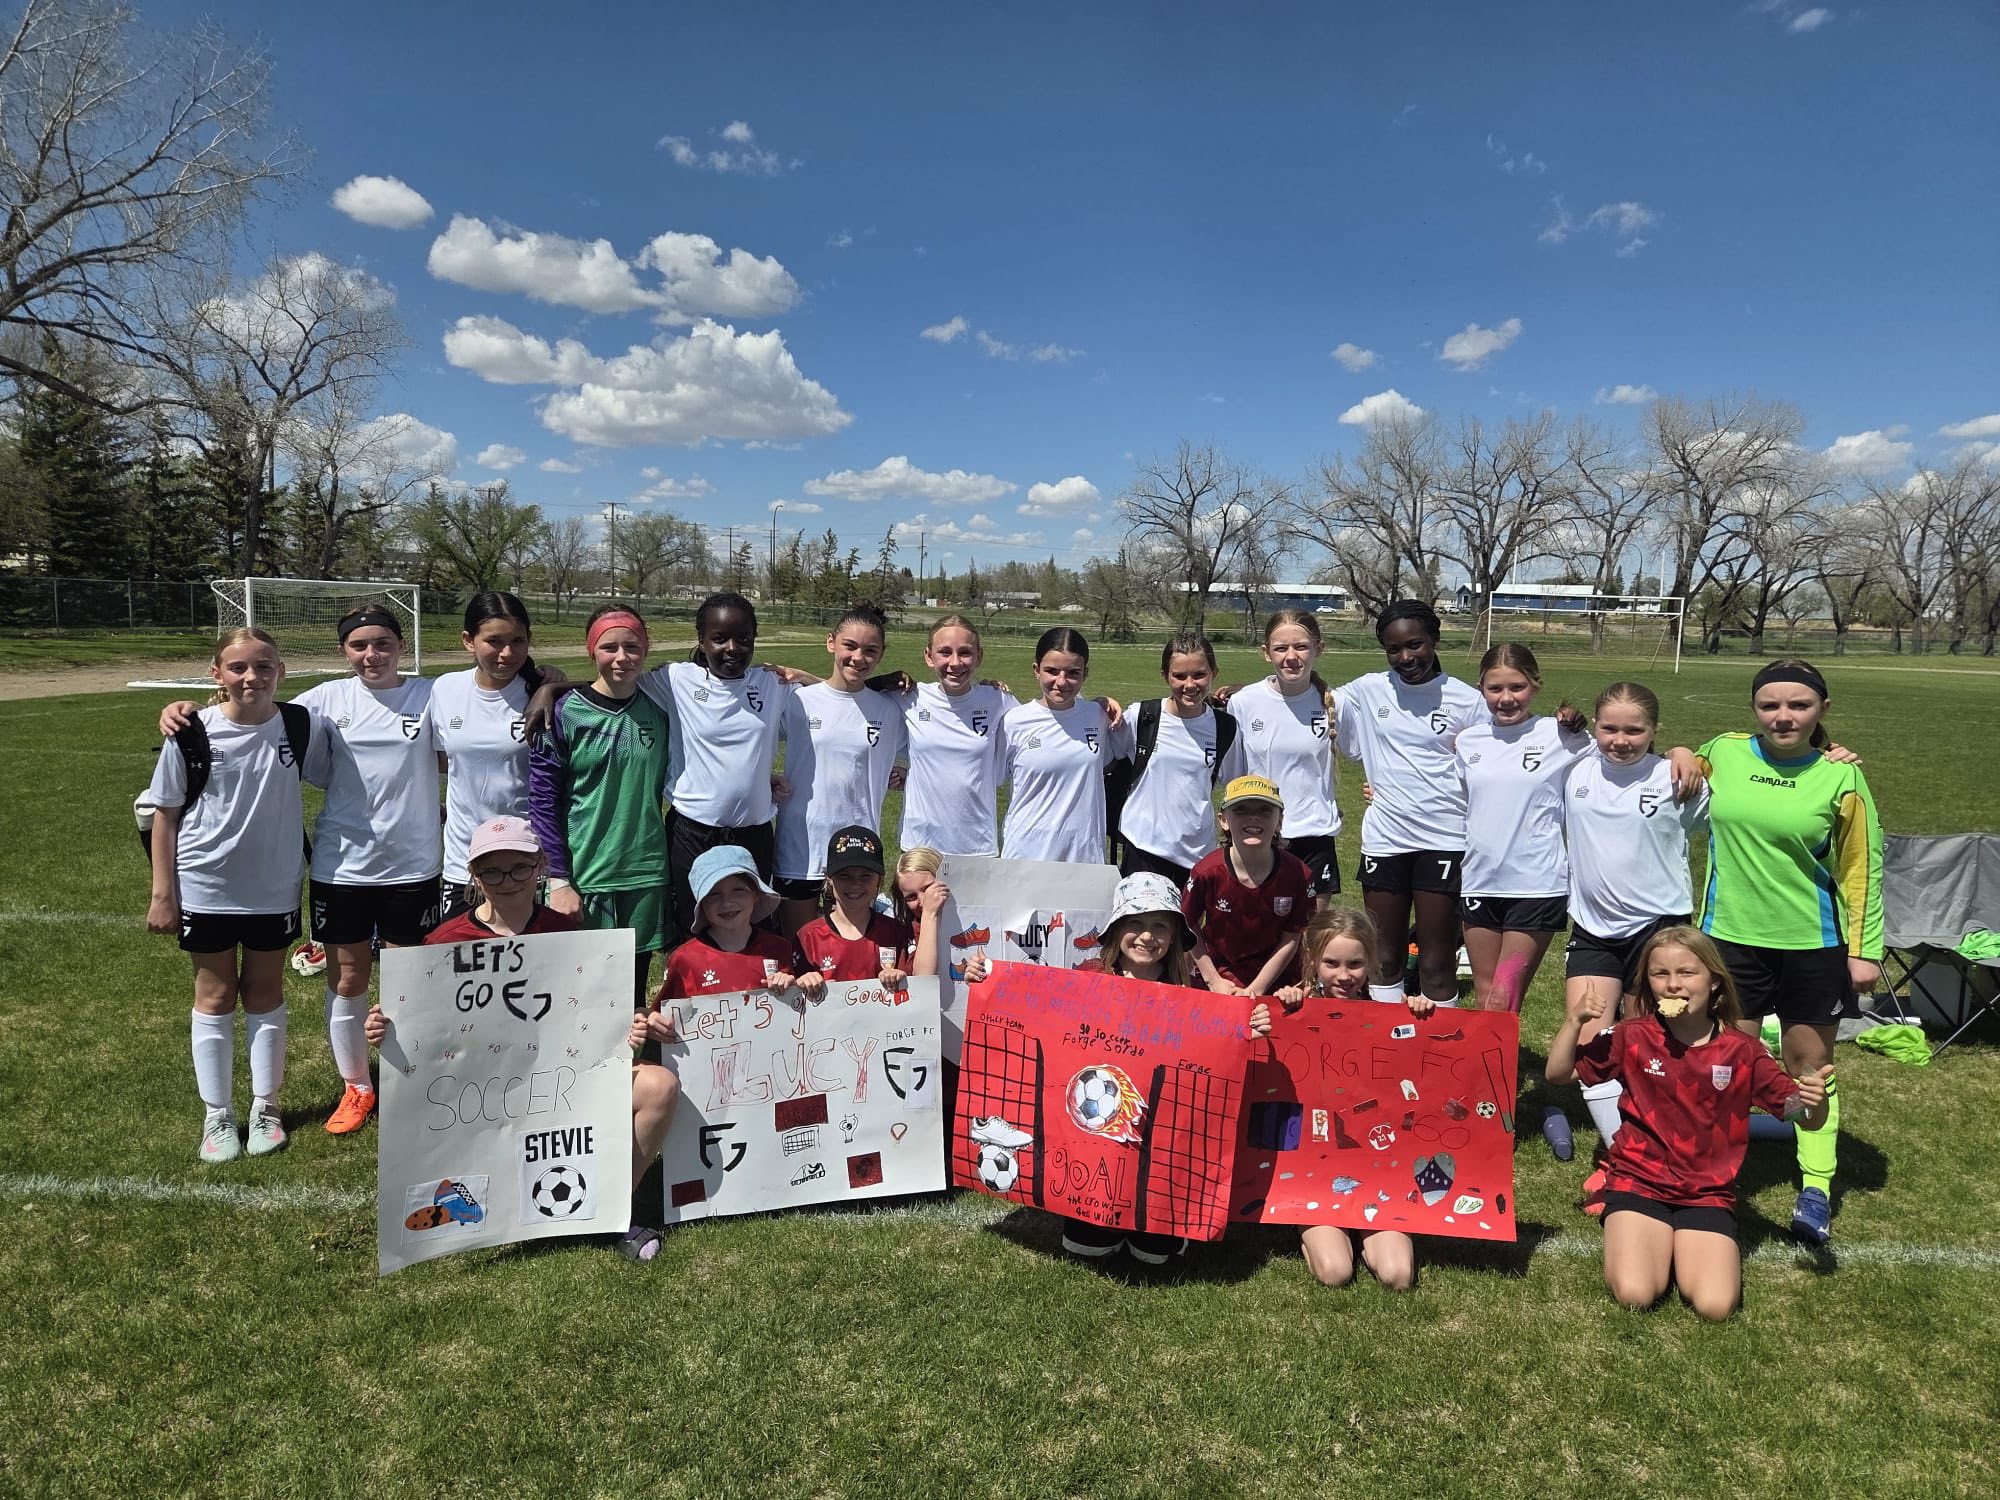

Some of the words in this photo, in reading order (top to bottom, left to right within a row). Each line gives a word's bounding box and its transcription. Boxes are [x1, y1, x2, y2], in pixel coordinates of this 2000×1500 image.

[1438, 860, 1451, 880] 7
[454, 940, 525, 973] LET'S
[456, 980, 493, 1012] GO
[427, 1066, 576, 1131] SOCCER
[525, 1126, 593, 1162] STEVIE
[1067, 1194, 1081, 1205] the
